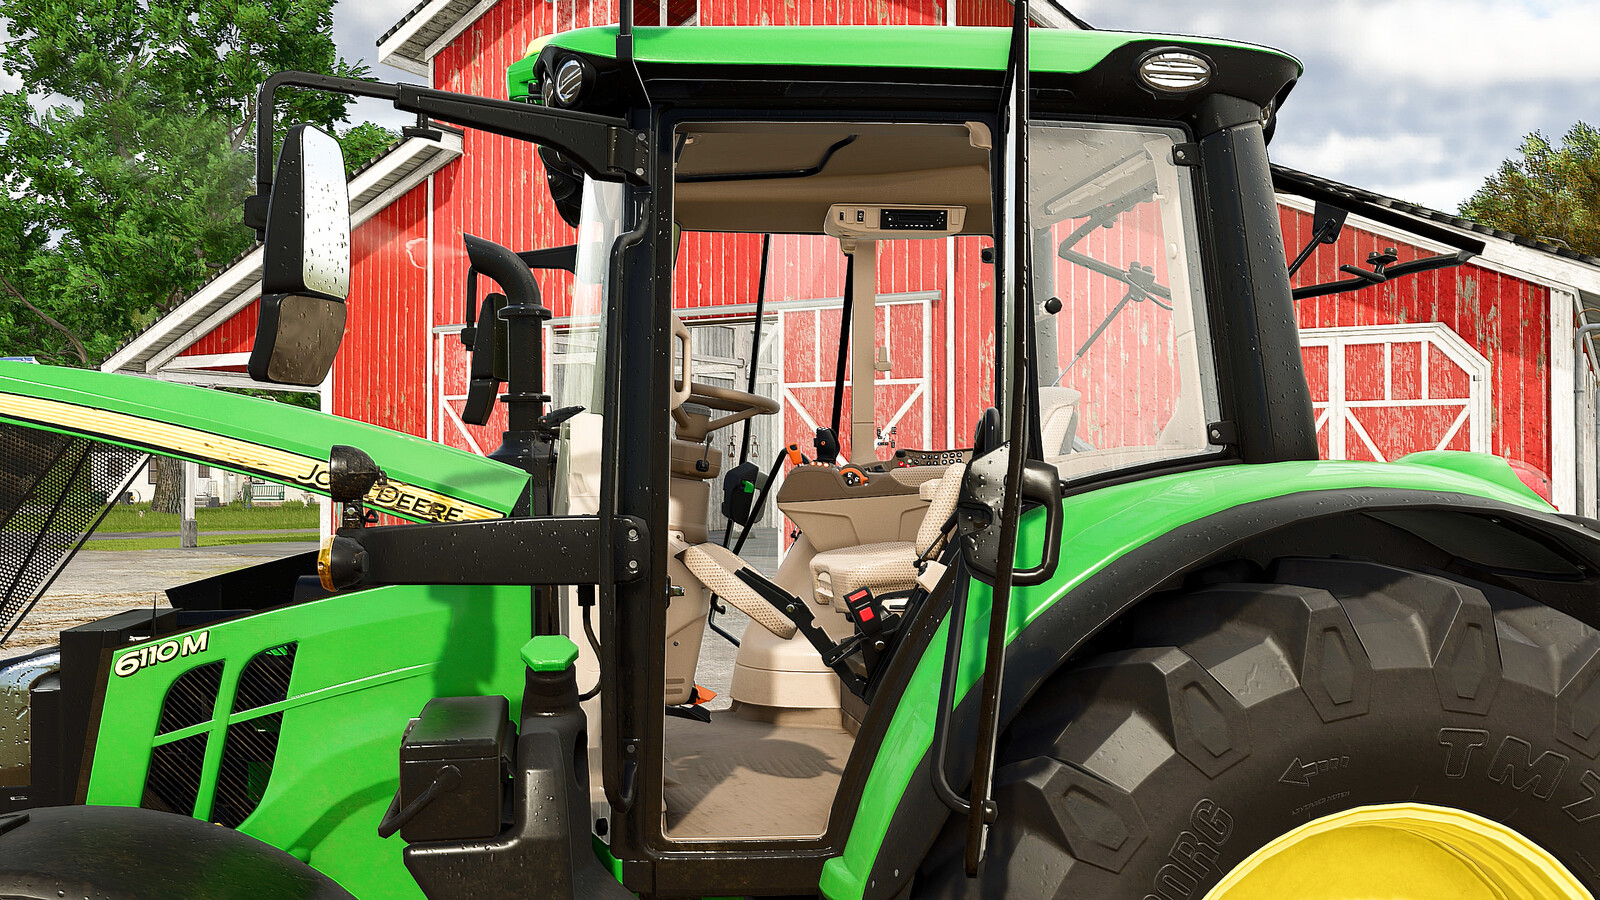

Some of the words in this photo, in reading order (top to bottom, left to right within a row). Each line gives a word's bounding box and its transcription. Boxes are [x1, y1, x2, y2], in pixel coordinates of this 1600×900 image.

[298, 464, 331, 486] JO
[376, 485, 463, 520] DEERE
[1142, 798, 1234, 900] ORG
